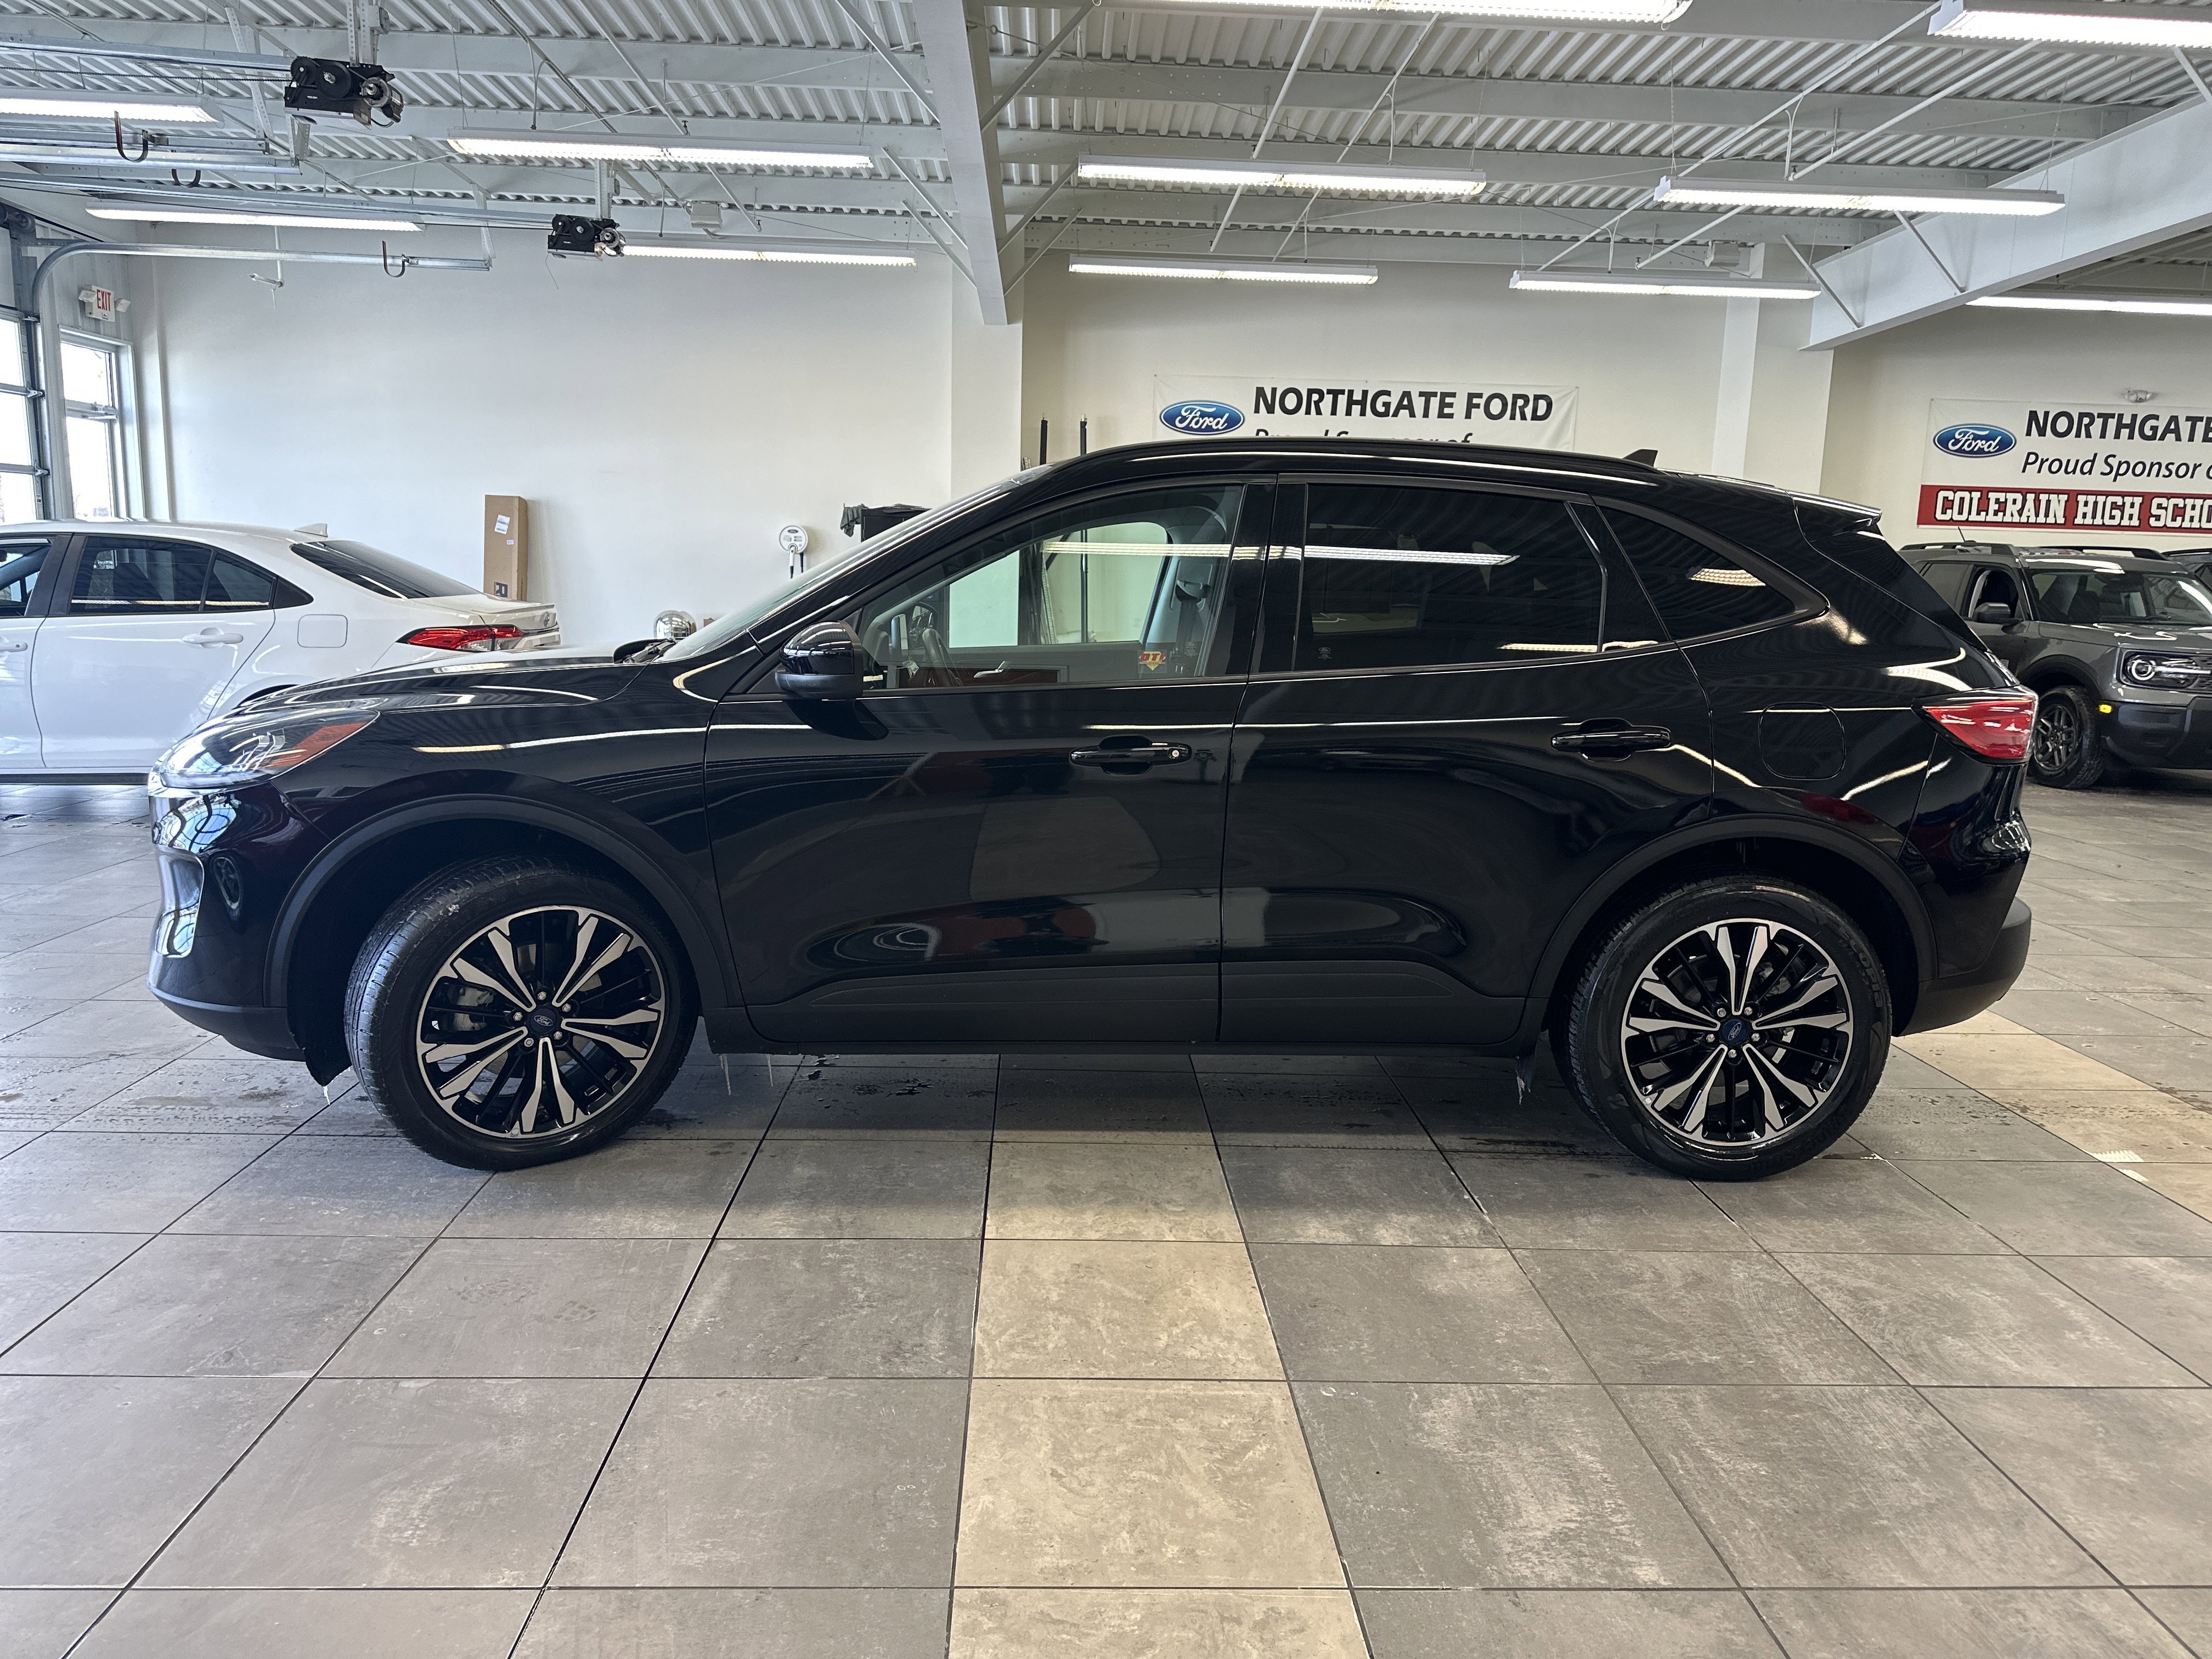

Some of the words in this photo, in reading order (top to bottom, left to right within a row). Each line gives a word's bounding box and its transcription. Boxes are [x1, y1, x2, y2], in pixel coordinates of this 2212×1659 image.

[97, 289, 111, 312] EXIT
[1254, 386, 1455, 419] NORTHGATE
[1464, 392, 1553, 421] FORD
[1175, 405, 1229, 430] Ford
[2025, 410, 2212, 443] NORTHGATE
[1948, 428, 2002, 453] Ford
[2021, 452, 2097, 476] Proud
[2101, 454, 2202, 483] Sponsor
[1935, 490, 2069, 525] COLERAIN
[2074, 494, 2142, 527] HIGH
[537, 1016, 551, 1026] Ford
[1729, 1024, 1741, 1038] Ford
